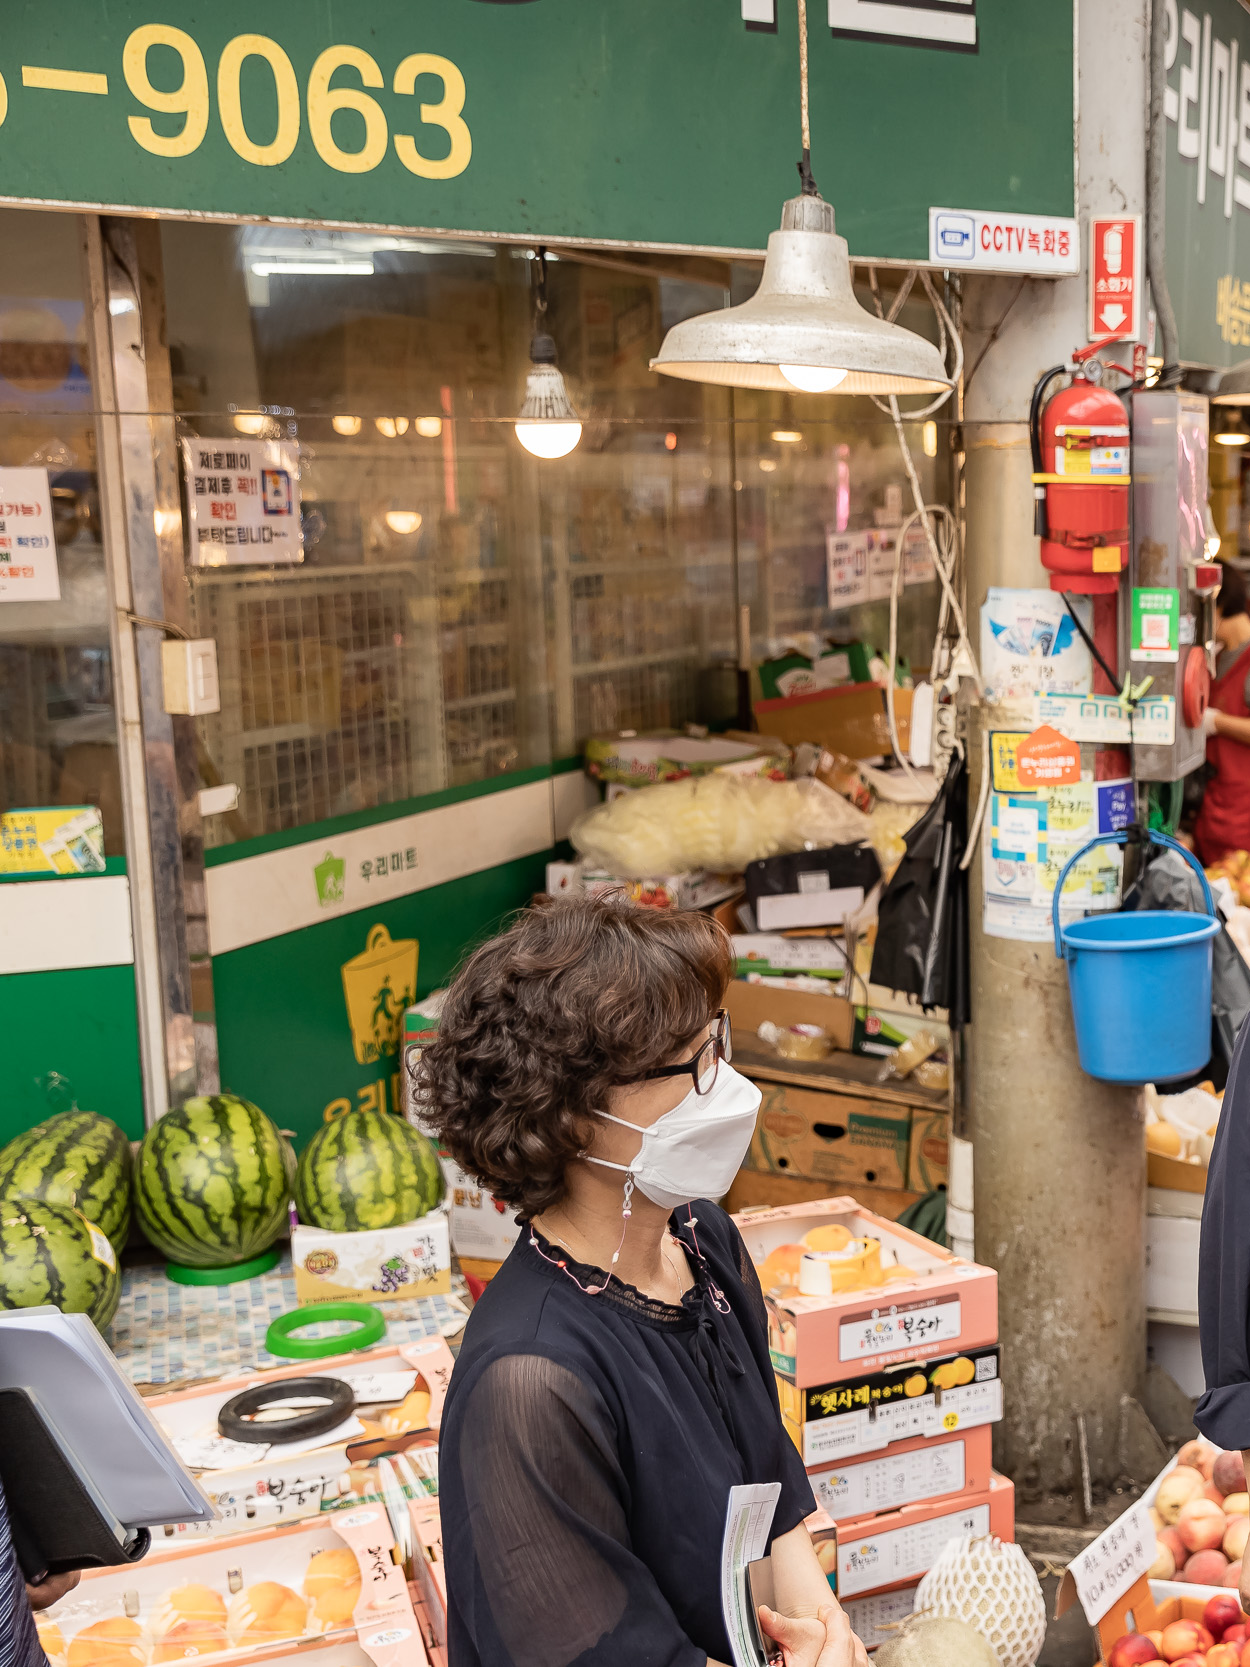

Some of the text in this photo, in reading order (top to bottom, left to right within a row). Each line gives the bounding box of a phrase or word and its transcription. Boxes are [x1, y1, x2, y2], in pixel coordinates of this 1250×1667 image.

[0, 22, 472, 181] -9063
[1096, 277, 1133, 293] 소화기
[200, 451, 251, 470] 제로페이
[194, 476, 233, 496] 결제후
[210, 501, 237, 521] 확인
[359, 847, 418, 881] 우리마트
[850, 1121, 898, 1138] Premium
[902, 1315, 943, 1343] 복숭아
